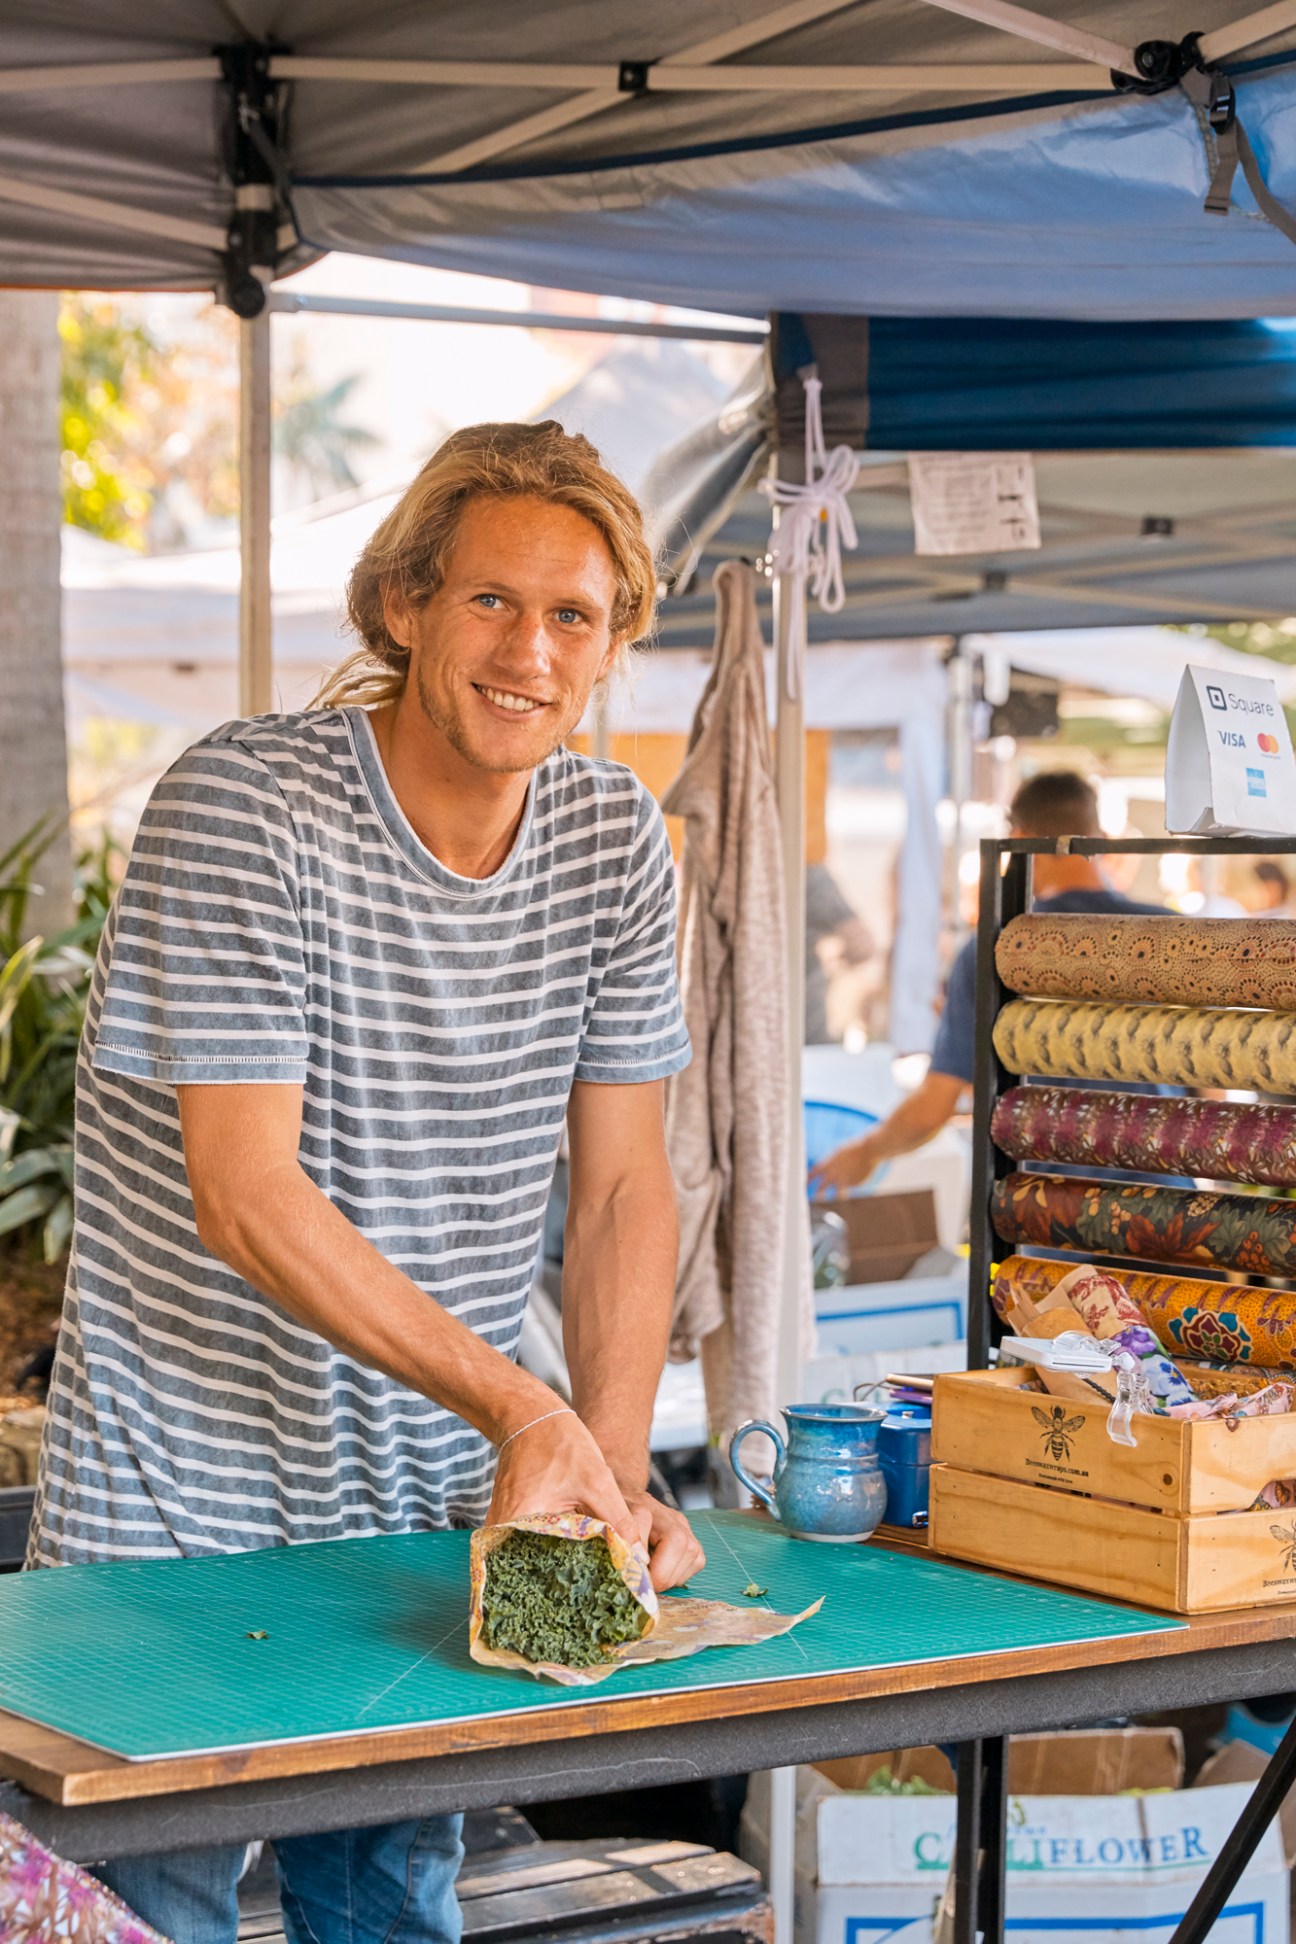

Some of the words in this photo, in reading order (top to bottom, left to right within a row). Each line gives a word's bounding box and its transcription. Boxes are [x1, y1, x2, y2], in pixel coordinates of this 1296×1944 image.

[1228, 693, 1274, 717] Square
[1217, 730, 1247, 749] VISA
[912, 1825, 1210, 1864] CLIFLOWER
